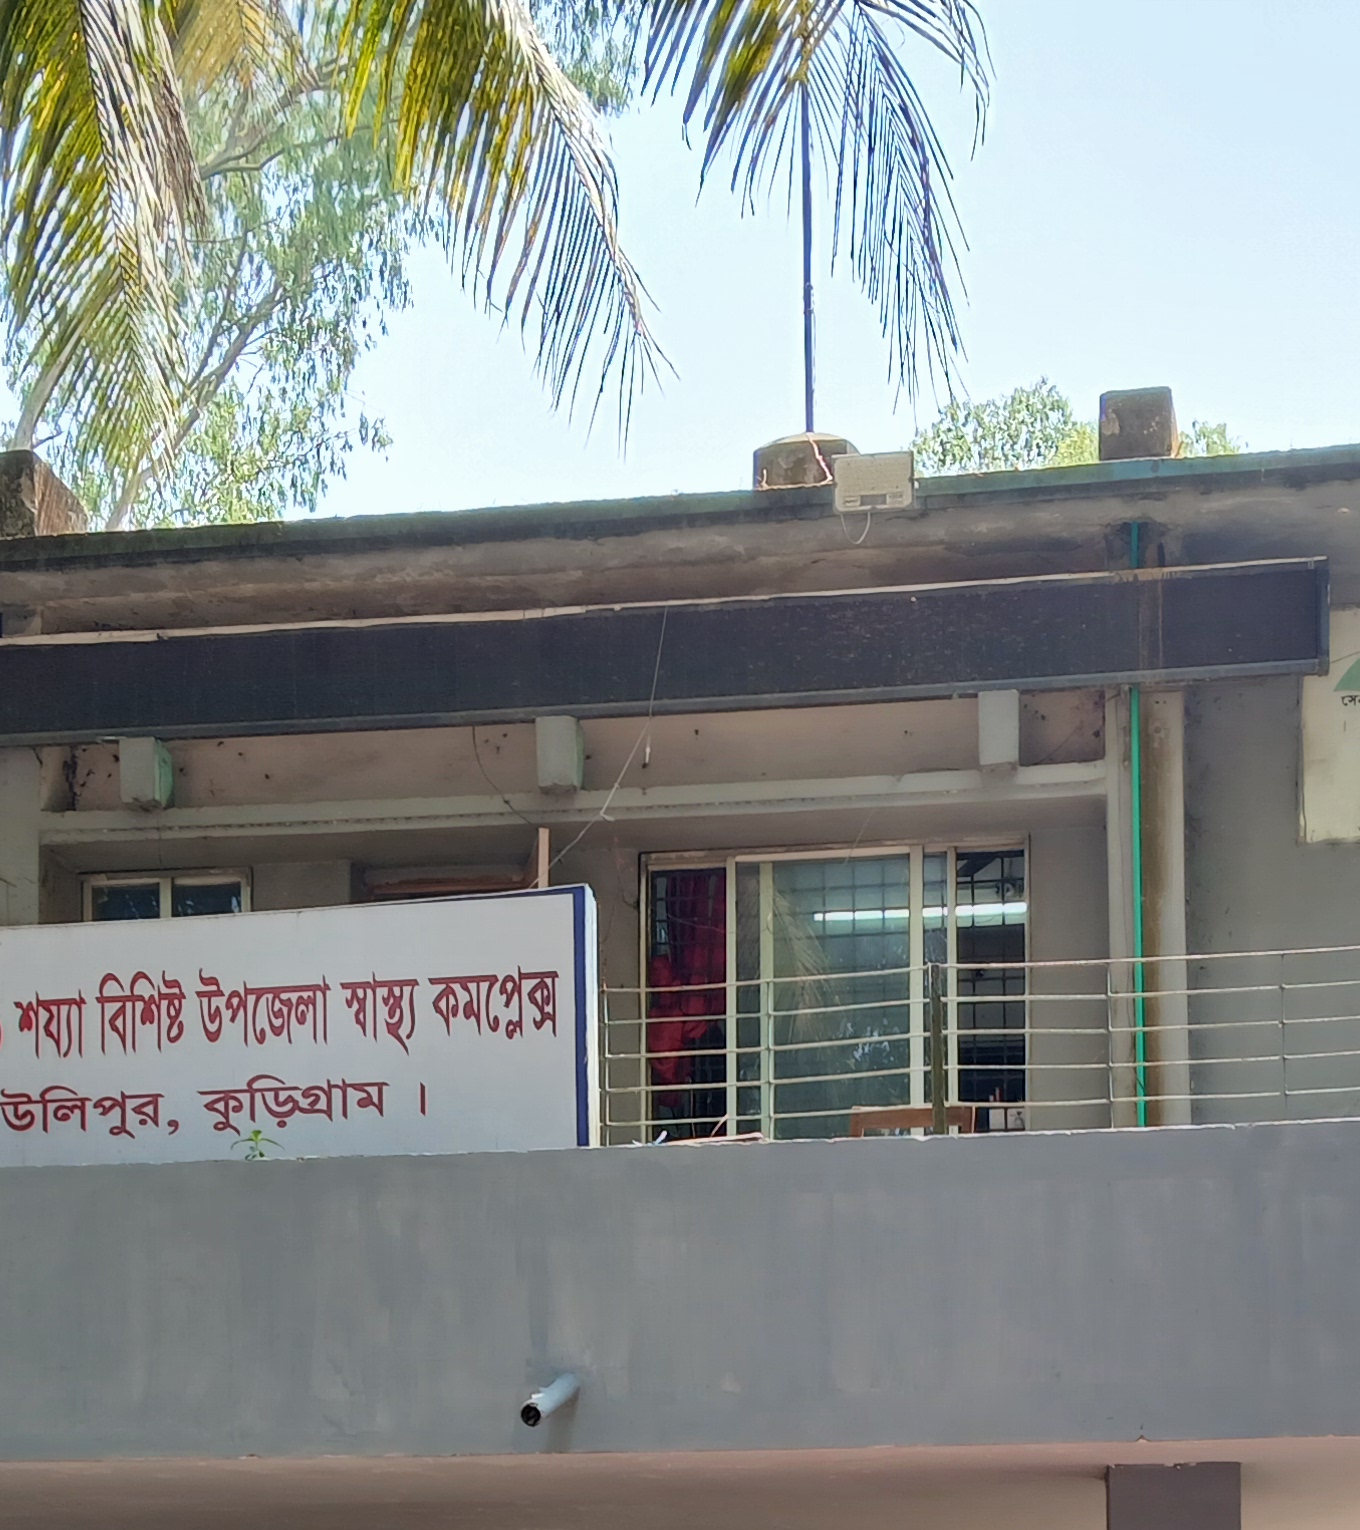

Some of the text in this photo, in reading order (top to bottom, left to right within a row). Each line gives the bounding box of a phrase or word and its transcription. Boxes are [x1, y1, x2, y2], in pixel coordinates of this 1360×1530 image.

[13, 989, 87, 1059] শয্যা
[95, 970, 187, 1055] বিশিষ্ট
[195, 967, 331, 1047] উপজেলা
[340, 971, 420, 1056] স্বাস্থ্য
[428, 965, 560, 1040] কমপ্লেক্স
[196, 1073, 391, 1137] কুড়িগ্রাম
